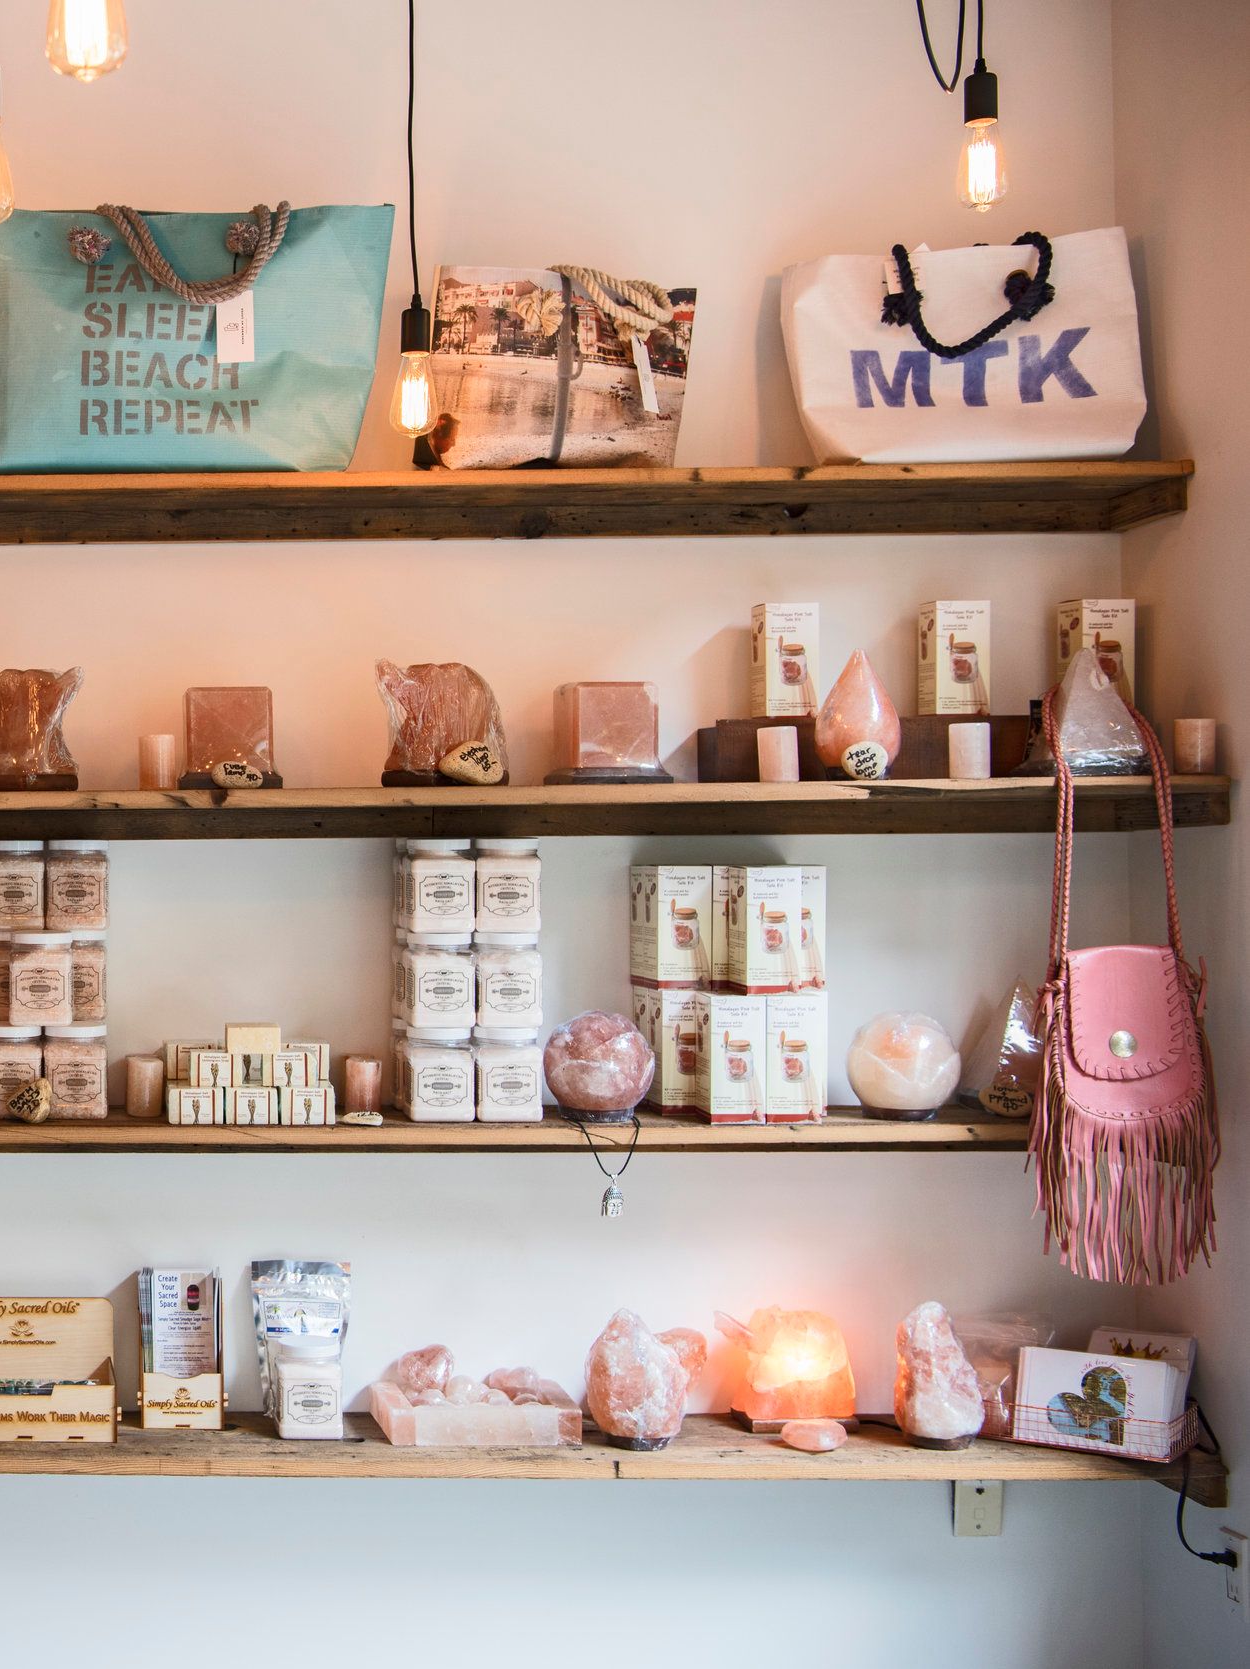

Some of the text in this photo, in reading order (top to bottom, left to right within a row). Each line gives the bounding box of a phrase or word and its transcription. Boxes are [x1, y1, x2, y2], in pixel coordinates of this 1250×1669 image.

[86, 264, 161, 294] EA
[81, 350, 239, 390] BEACH
[850, 326, 1098, 408] MTK
[80, 399, 259, 436] REPEAT
[846, 747, 870, 760] tear
[855, 753, 876, 767] drop
[8, 1300, 48, 1315] Sacred
[146, 1400, 173, 1409] Simply
[173, 1399, 199, 1408] Sacred
[17, 1411, 46, 1423] WORK
[50, 1411, 76, 1423] THEIR
[80, 1411, 110, 1423] MAGIC
